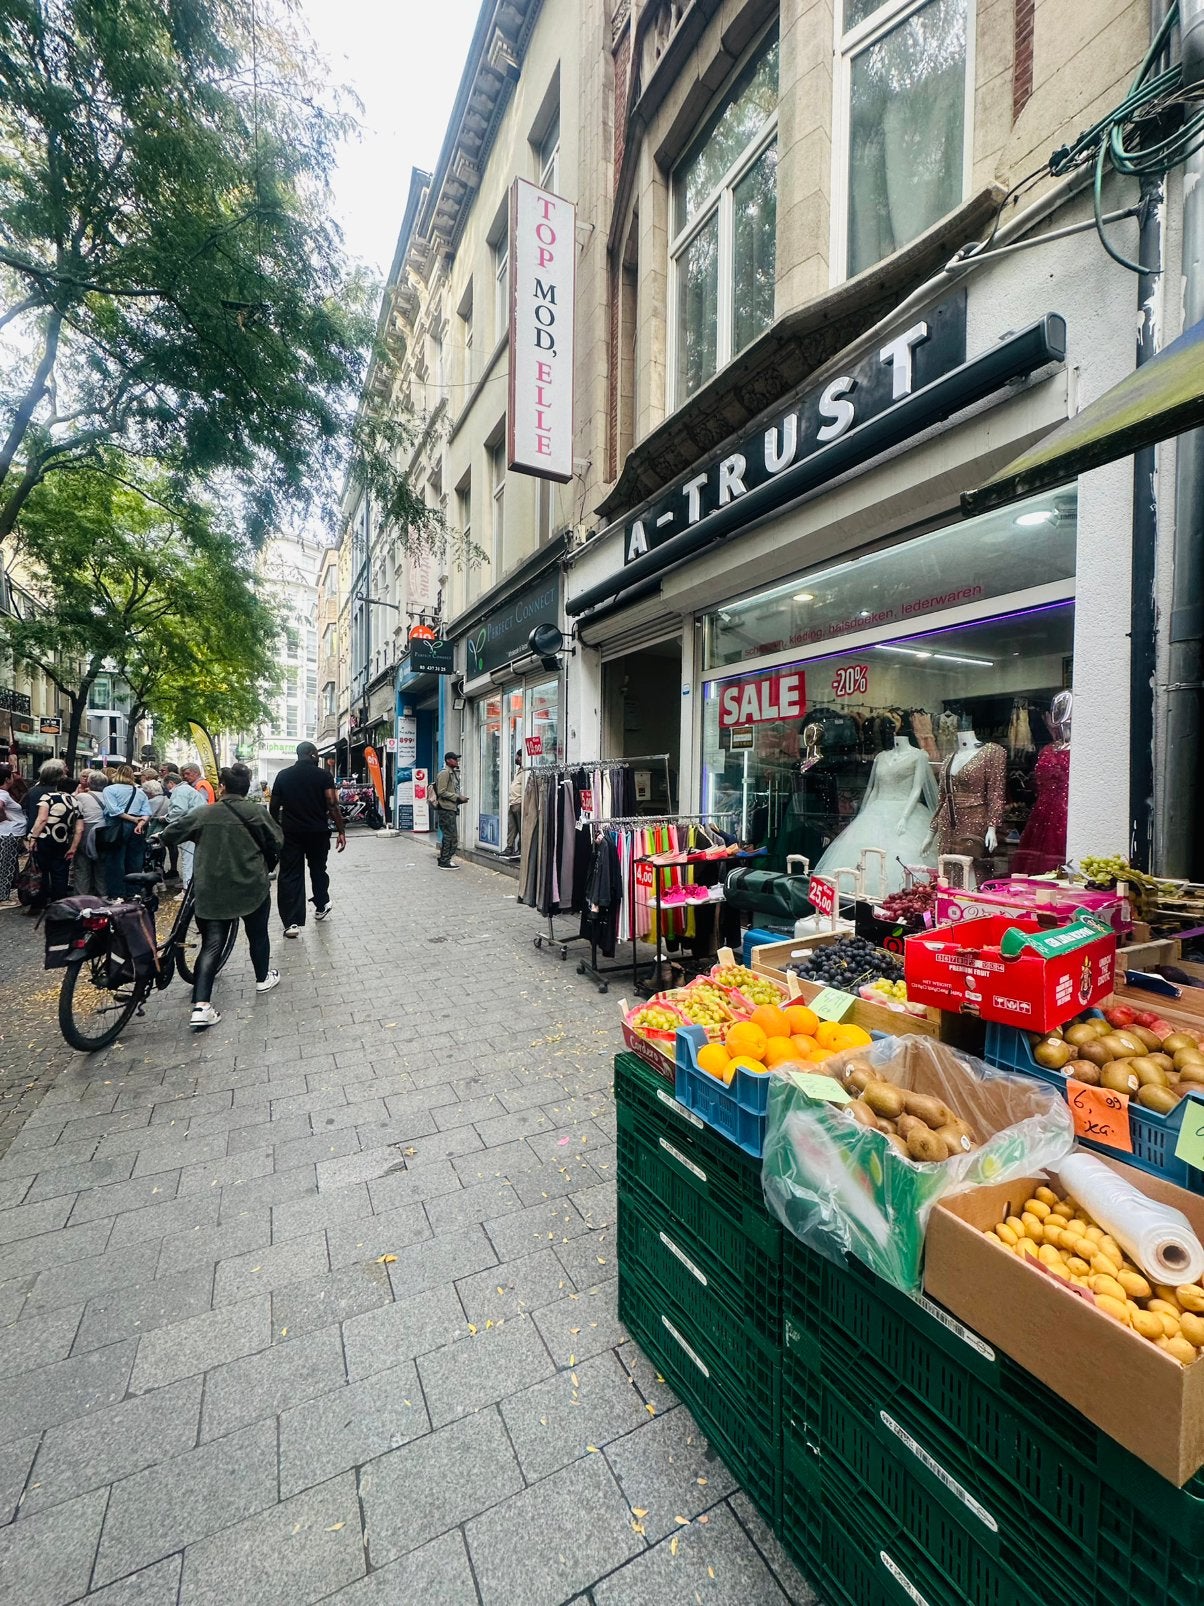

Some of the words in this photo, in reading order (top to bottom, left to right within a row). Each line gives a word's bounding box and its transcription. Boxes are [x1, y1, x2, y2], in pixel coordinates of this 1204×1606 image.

[535, 196, 556, 270] TOP
[535, 360, 552, 456] ELLE
[627, 320, 929, 561] A-TRUST
[901, 584, 982, 614] lederwaren
[723, 674, 799, 725] SALE
[810, 881, 832, 911] 25,00
